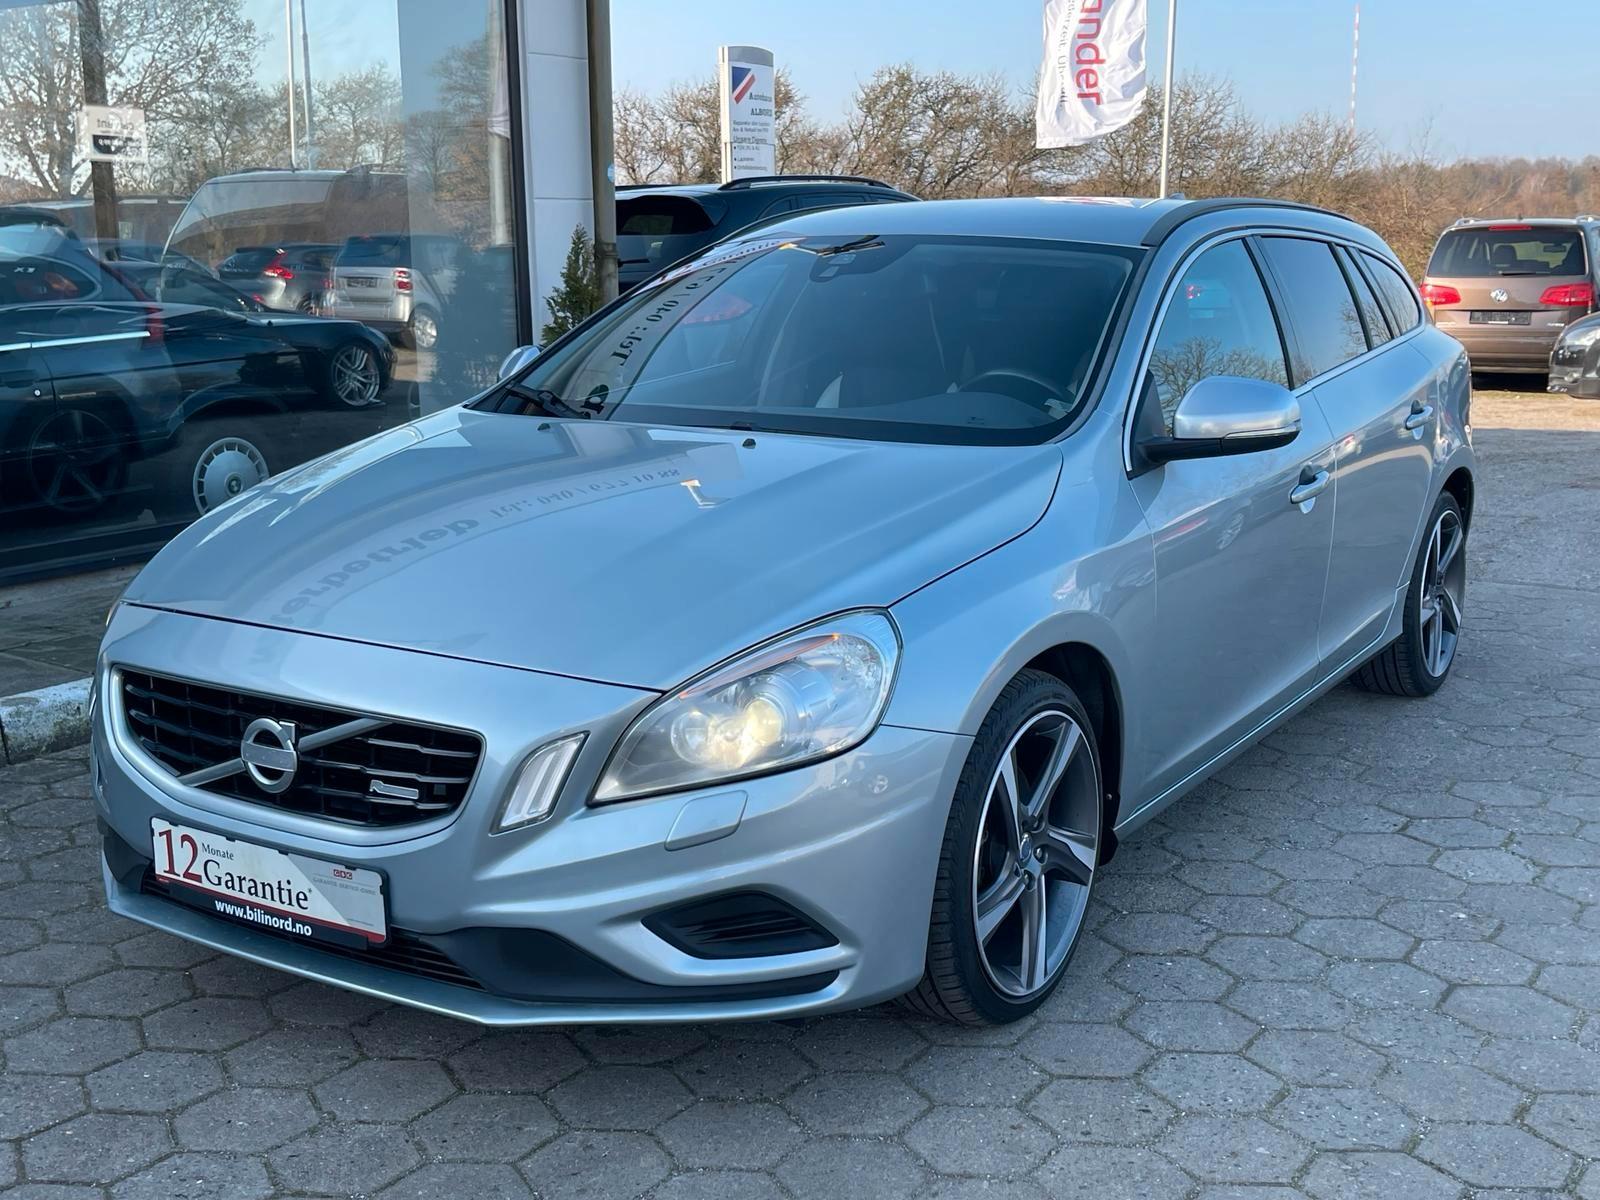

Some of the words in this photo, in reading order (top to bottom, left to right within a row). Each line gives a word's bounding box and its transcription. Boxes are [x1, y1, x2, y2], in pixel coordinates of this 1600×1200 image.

[158, 829, 203, 884] 12
[201, 842, 235, 861] Monate
[214, 900, 313, 937] www.bilinord.no
